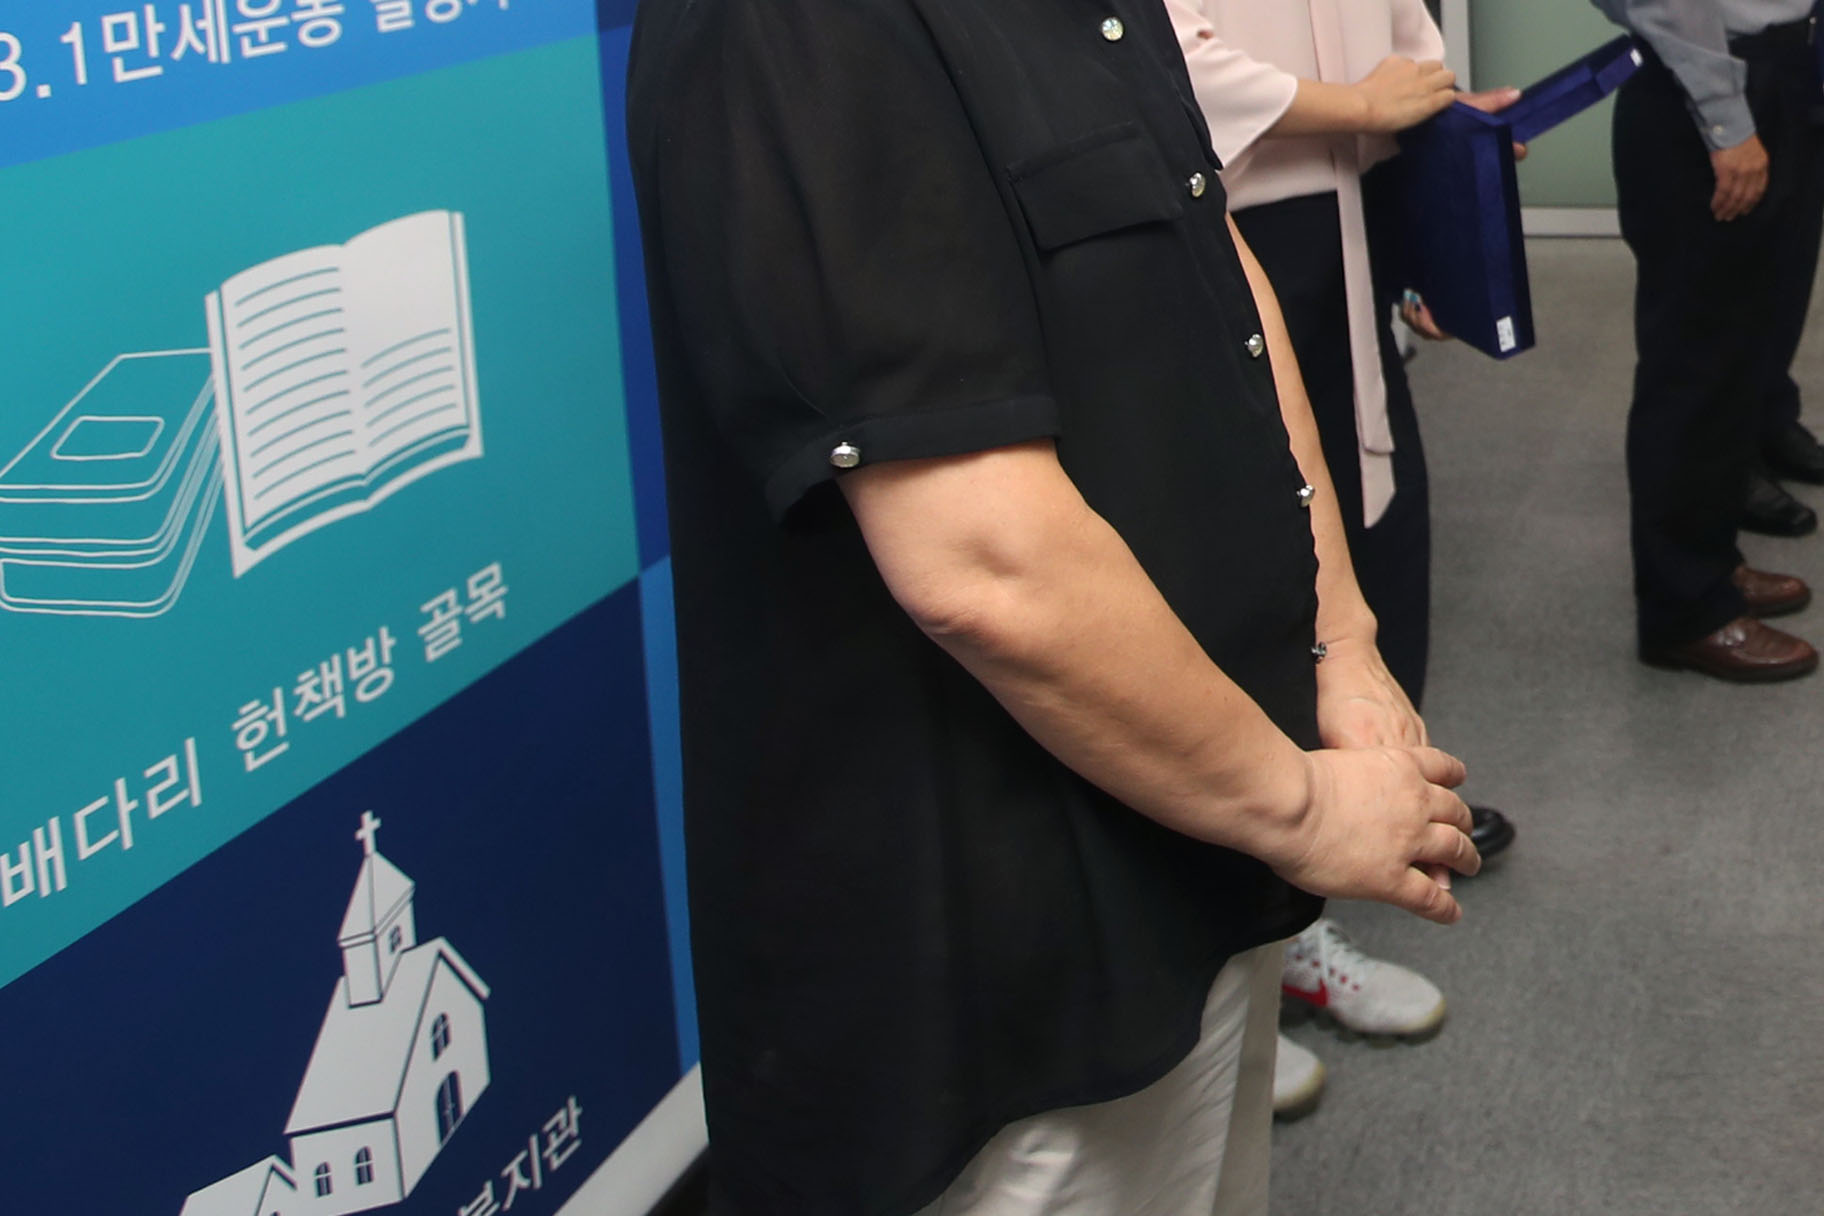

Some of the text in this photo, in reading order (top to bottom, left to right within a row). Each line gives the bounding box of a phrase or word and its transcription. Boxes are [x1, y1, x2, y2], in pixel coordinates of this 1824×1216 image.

[0, 562, 508, 908] 배다리 헌책방 골목
